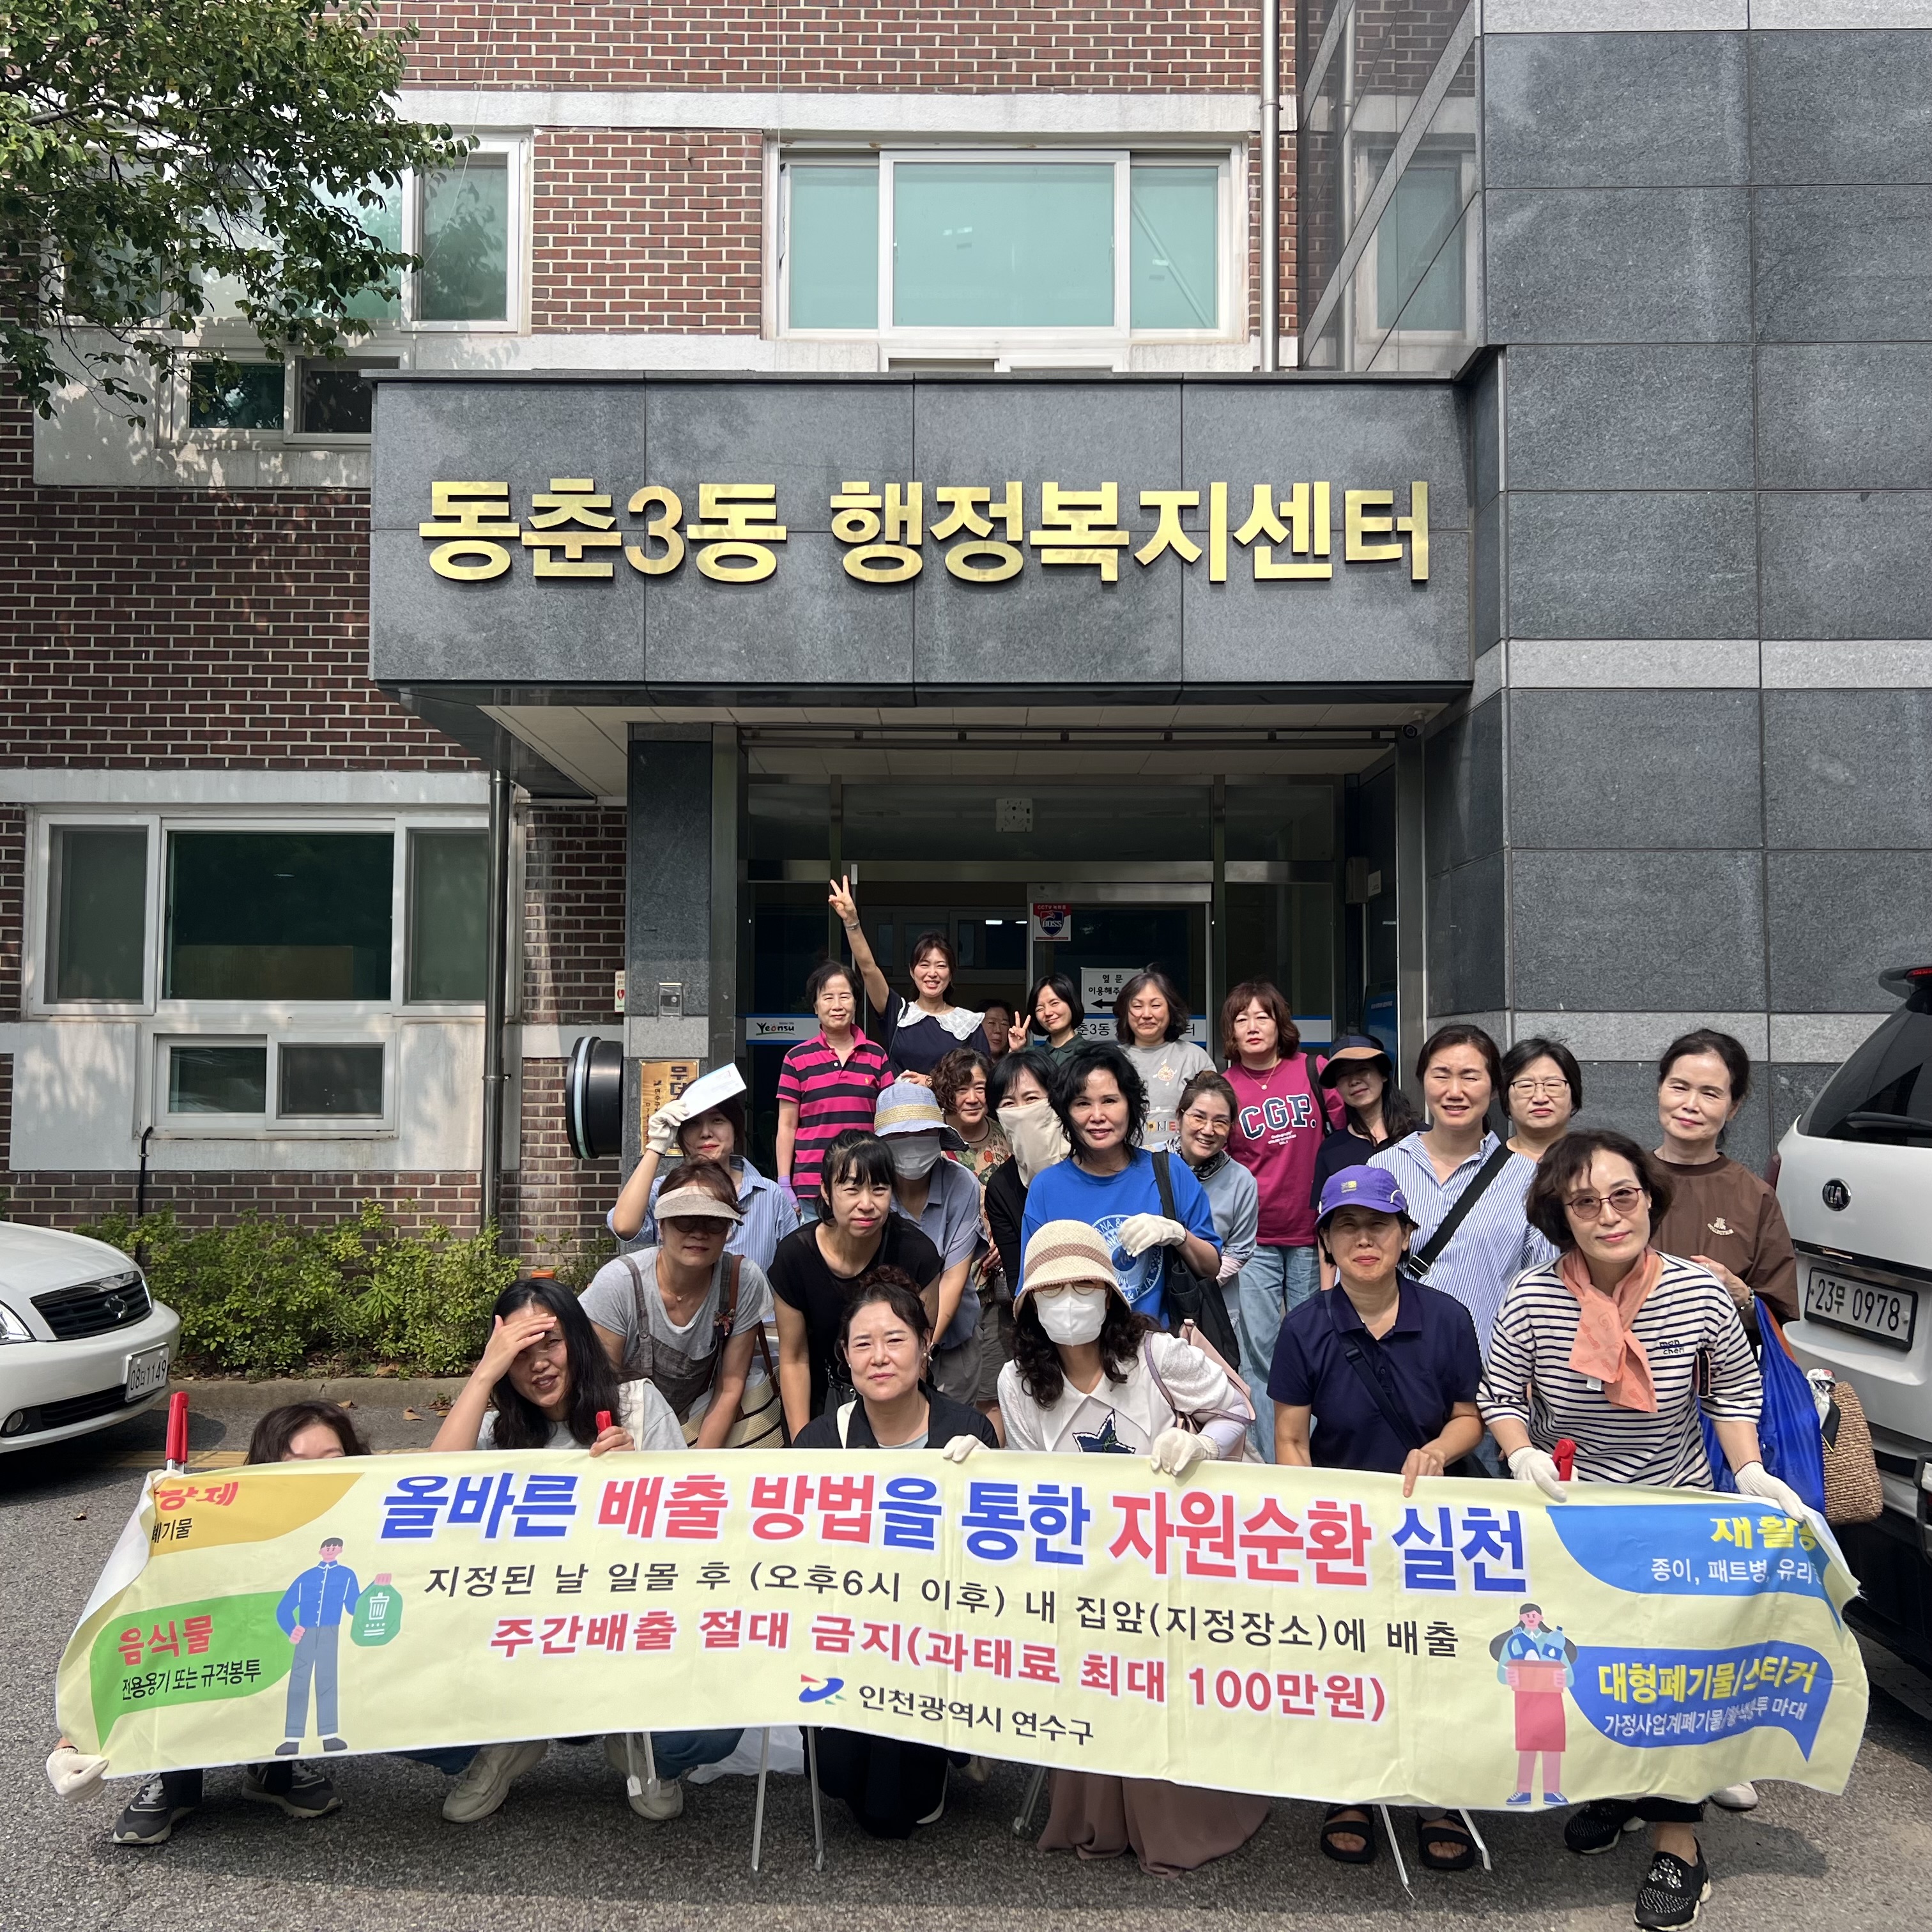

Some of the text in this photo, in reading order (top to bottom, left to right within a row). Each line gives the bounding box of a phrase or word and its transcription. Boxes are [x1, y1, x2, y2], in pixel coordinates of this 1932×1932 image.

[419, 478, 1429, 583] 동춘3동 행정복지센터
[1088, 986, 1120, 996] 이용해주
[756, 1022, 795, 1034] Yeonsu
[1824, 1184, 1843, 1205] KIA
[1815, 1278, 1901, 1331] 23무 0978
[154, 1482, 239, 1511] 량제
[381, 1472, 1527, 1593] 올바른 배출 방법을 통한 자원순환 실천
[1651, 1558, 1700, 1586] 종이,
[424, 1561, 1459, 1658] 지정된 날 일몰 후 (오후6시 이후) 내 집앞(지정장소)에 배출
[118, 1614, 213, 1666] 음식물
[122, 1659, 261, 1701] 전용용기 또는 규격봉투
[490, 1609, 1386, 1722] 주간배출 절대 금지(과태료 최대 100만원)
[1598, 1655, 1818, 1704] 대형폐기물/스티커
[858, 1684, 1094, 1747] 인천광역시 연수구
[1771, 1697, 1808, 1721] 마대
